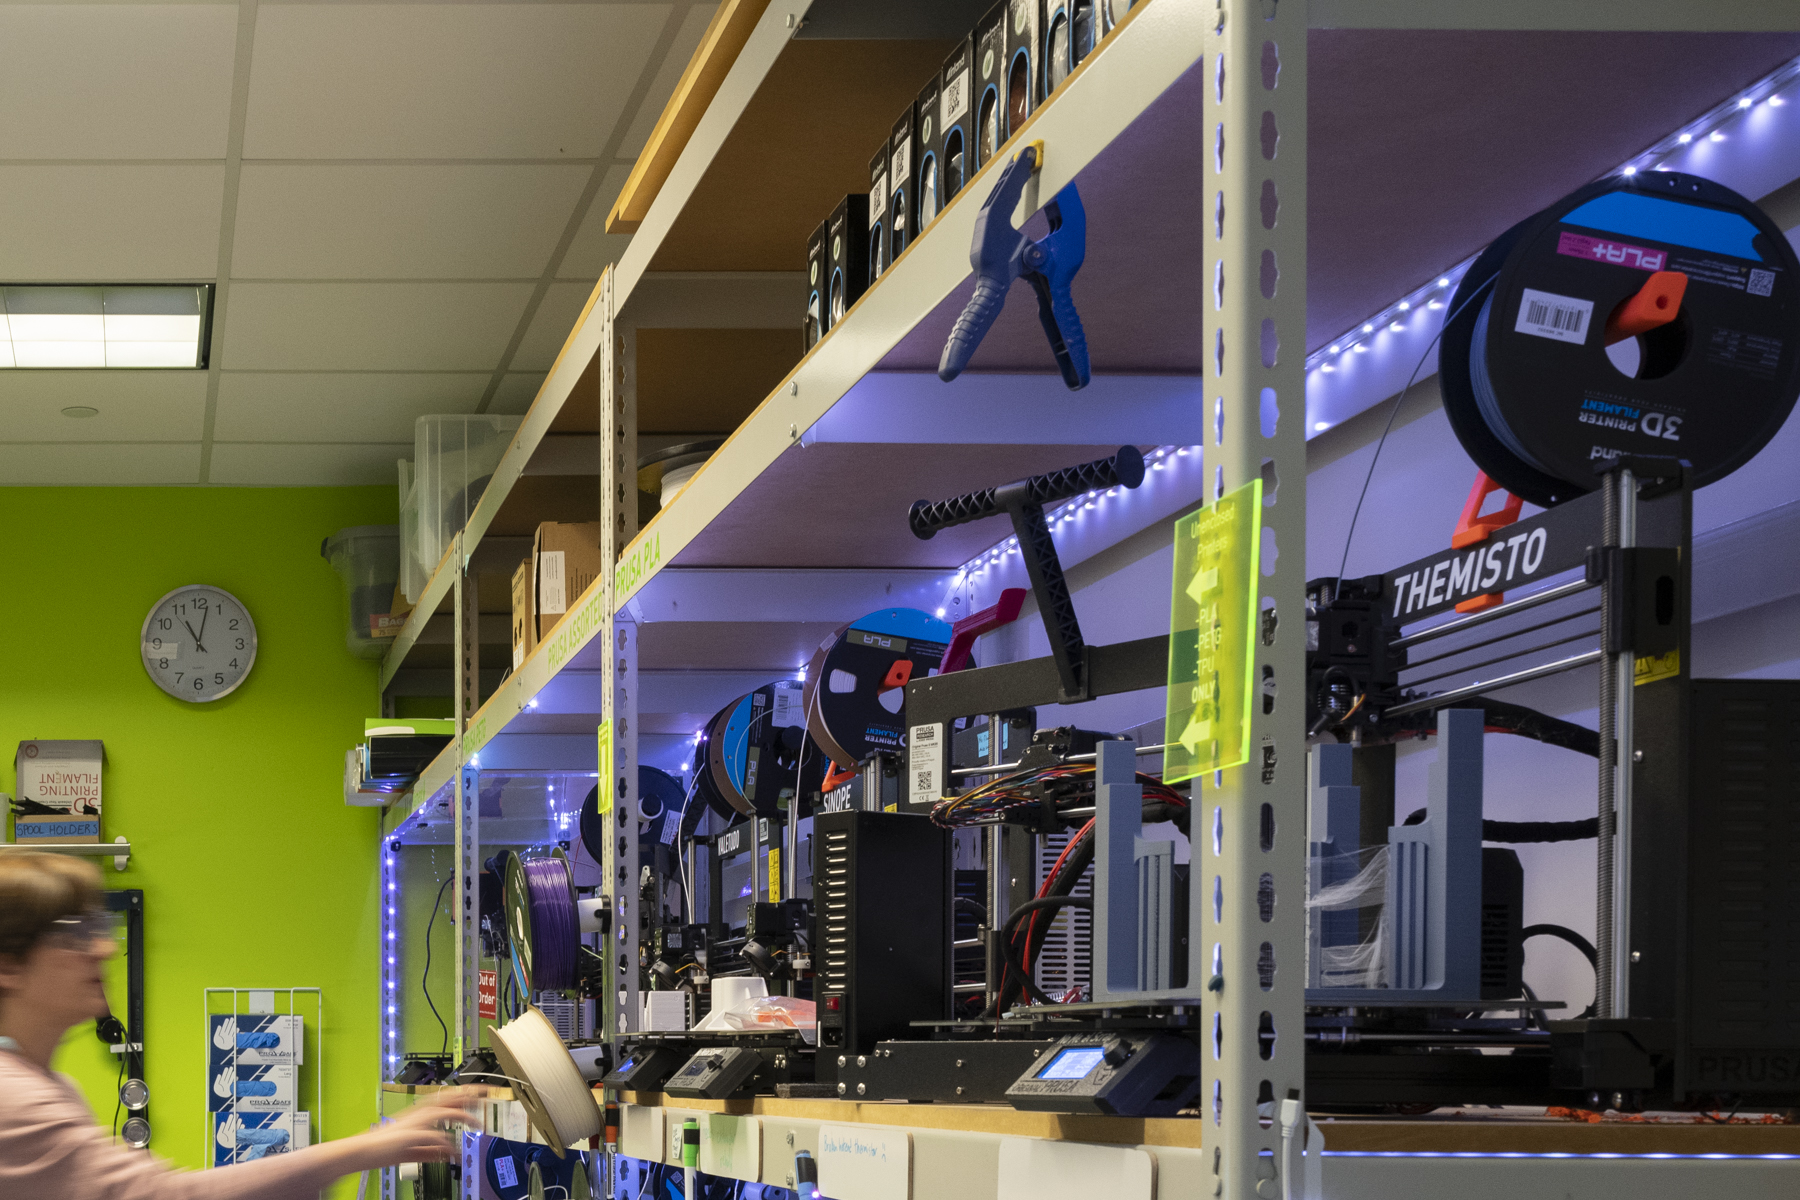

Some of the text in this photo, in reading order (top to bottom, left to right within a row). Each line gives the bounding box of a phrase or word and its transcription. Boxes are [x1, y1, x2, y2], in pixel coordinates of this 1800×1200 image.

[1592, 243, 1663, 270] PLA+
[1579, 399, 1683, 441] 3D PRINTER FILAMENT
[1191, 503, 1235, 538] Unenclosed
[1198, 536, 1228, 558] Printers
[615, 531, 661, 602] PRUSA PLA
[1393, 527, 1547, 618] THEMISTO
[172, 604, 186, 615] 11
[191, 598, 207, 610] 12
[216, 604, 222, 615] 1
[1195, 604, 1218, 625] -PLA
[157, 618, 172, 630] 10
[229, 620, 239, 631] 2
[152, 638, 162, 650] 9
[235, 639, 245, 650] 3
[863, 634, 892, 647] PLA
[1194, 626, 1222, 653] -PETG
[548, 630, 567, 675] PRUSA
[159, 658, 169, 669] 8
[229, 658, 239, 669] 4
[1193, 653, 1215, 677] -TPU
[175, 672, 184, 684] 7
[193, 678, 203, 690] 6
[214, 673, 224, 685] 5
[1192, 679, 1216, 703] ONLY
[865, 727, 898, 746] PRINTER FILAMENT
[39, 773, 98, 784] FILAMENT
[747, 760, 757, 785] PLA
[40, 785, 98, 796] PRINTING
[823, 784, 851, 813] SINOPE
[17, 823, 98, 836] SPOOL HOLDERS
[490, 975, 495, 986] of
[1702, 1056, 1800, 1081] PRUS
